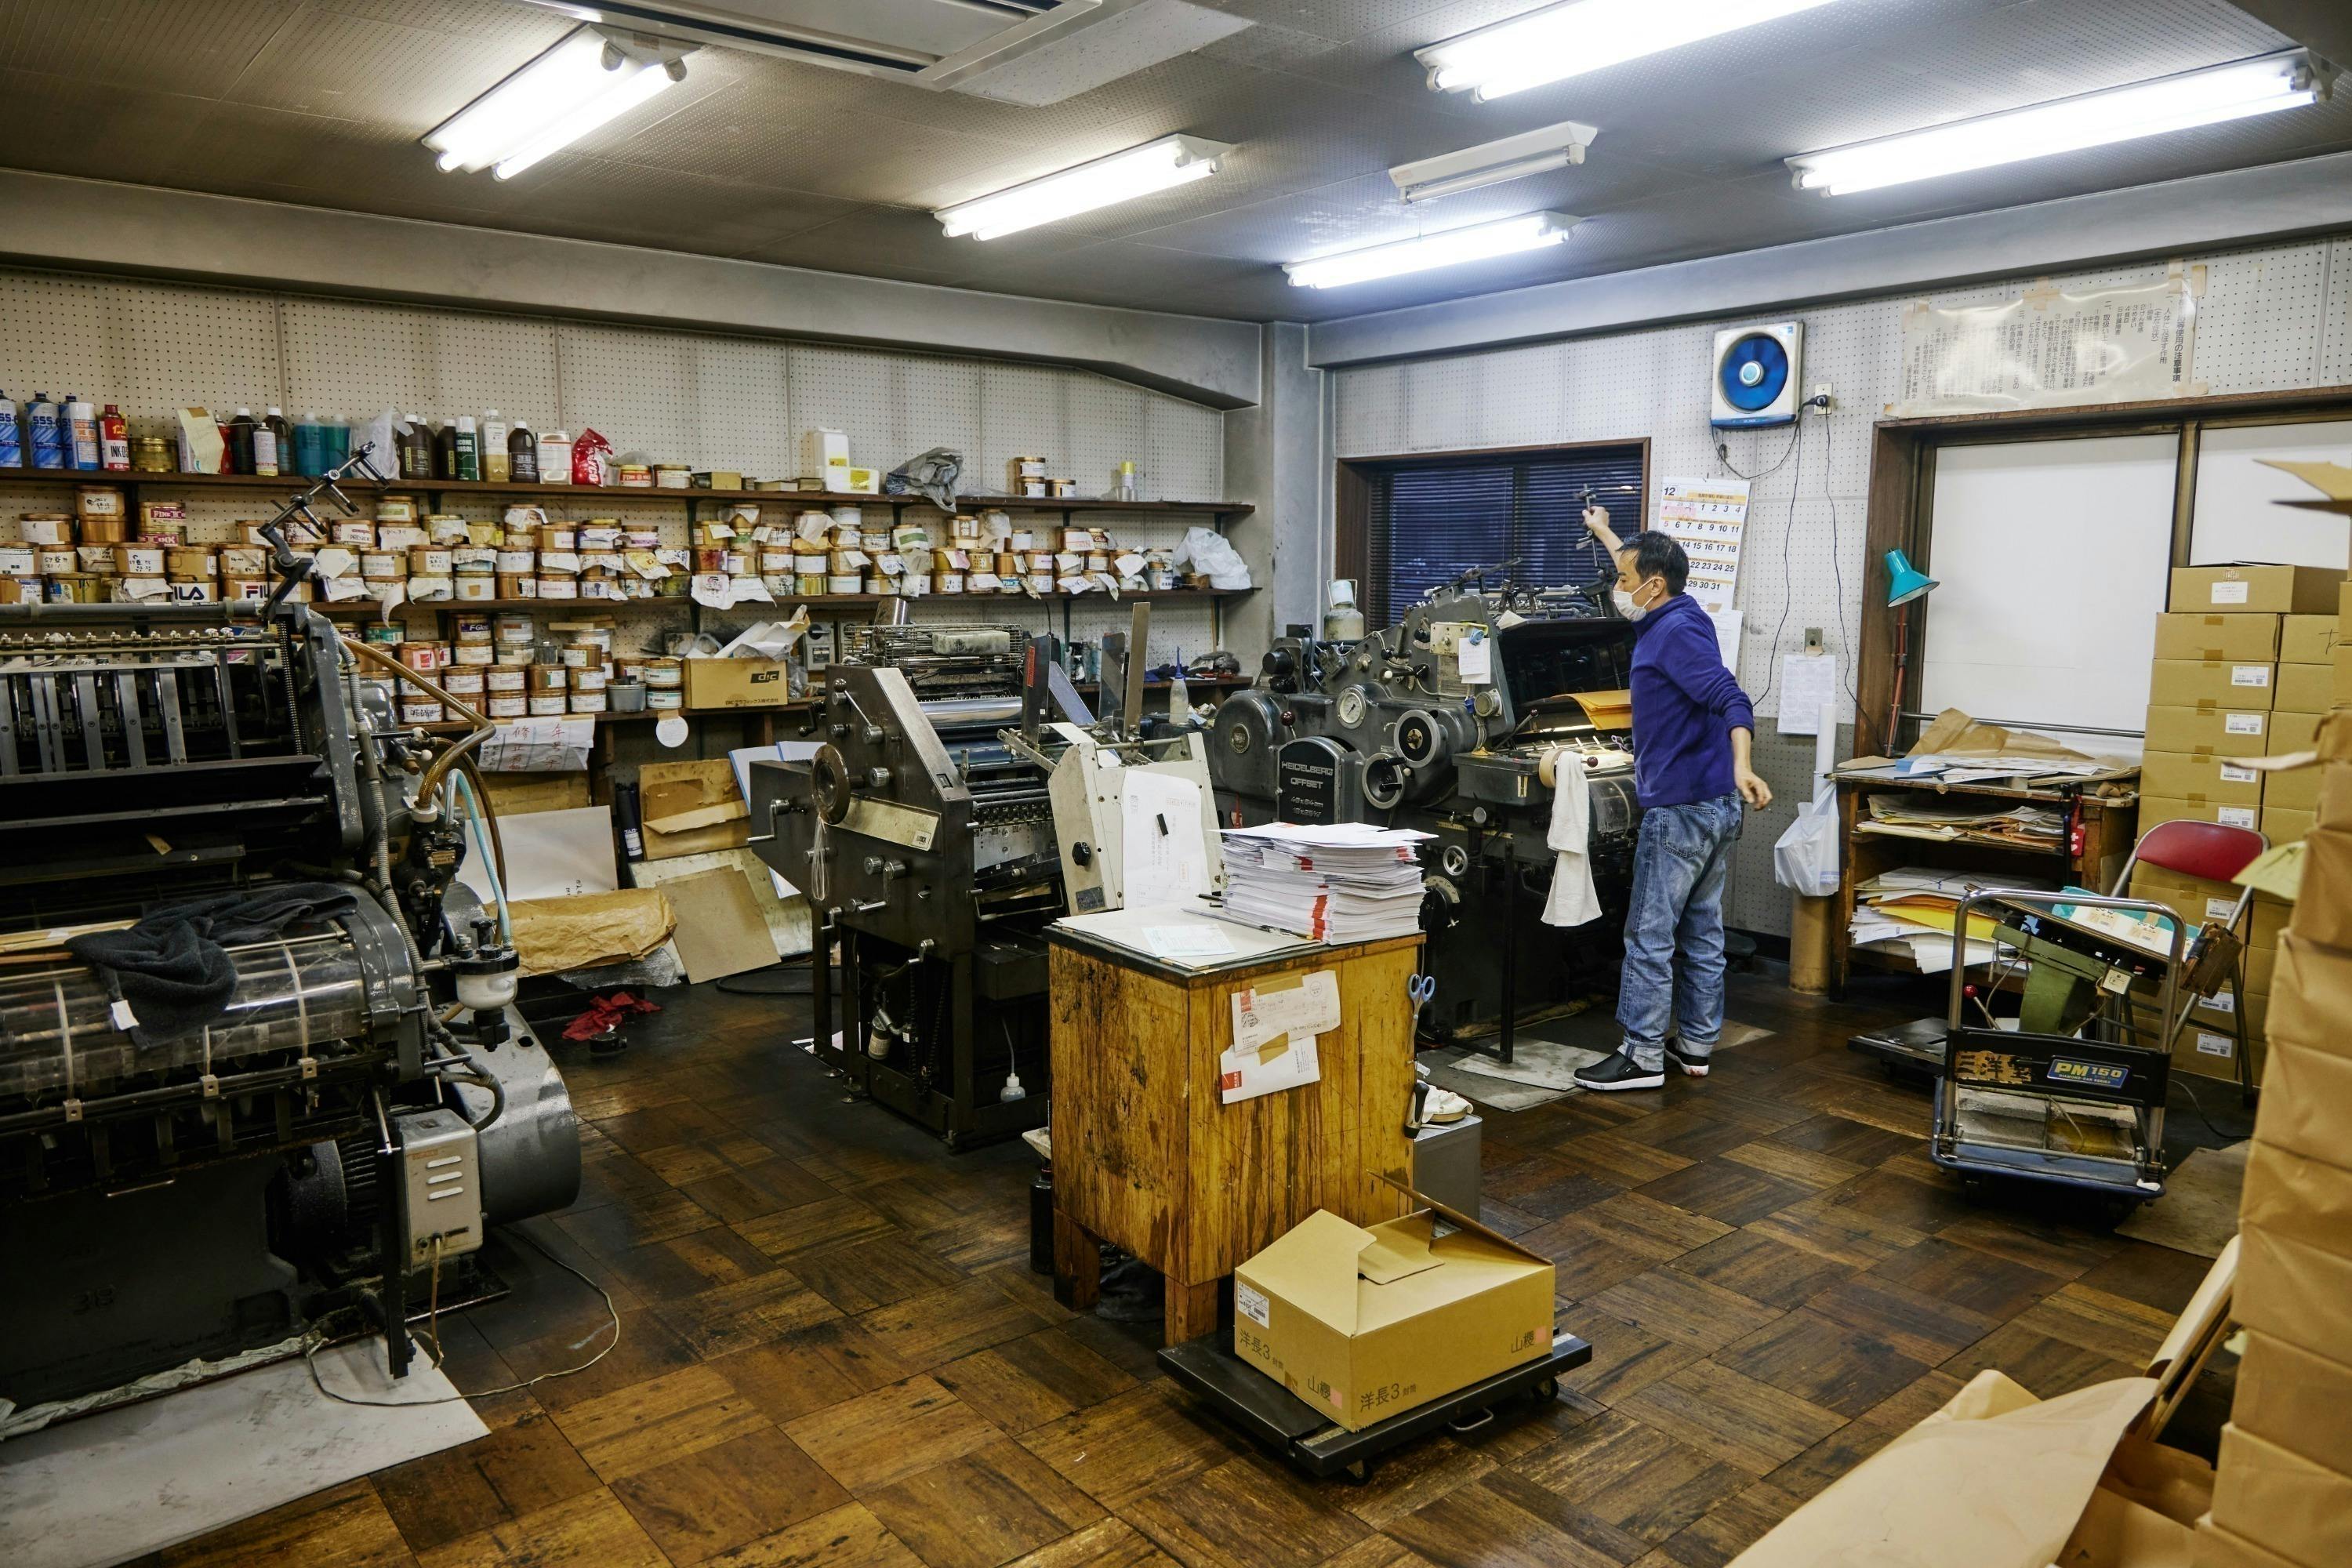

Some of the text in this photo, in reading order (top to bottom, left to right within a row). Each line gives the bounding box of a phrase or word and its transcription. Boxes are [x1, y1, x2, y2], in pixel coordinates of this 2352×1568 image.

[1664, 487, 1675, 495] 12
[172, 586, 205, 601] ILA
[245, 585, 270, 599] FIL
[1281, 760, 1334, 776] HEIDELBERG
[1290, 777, 1324, 789] OFFSET
[2054, 1062, 2089, 1076] PM
[2091, 1066, 2123, 1078] 150
[1240, 1329, 1270, 1360] 洋長3
[1360, 1383, 1400, 1413] 洋長3
